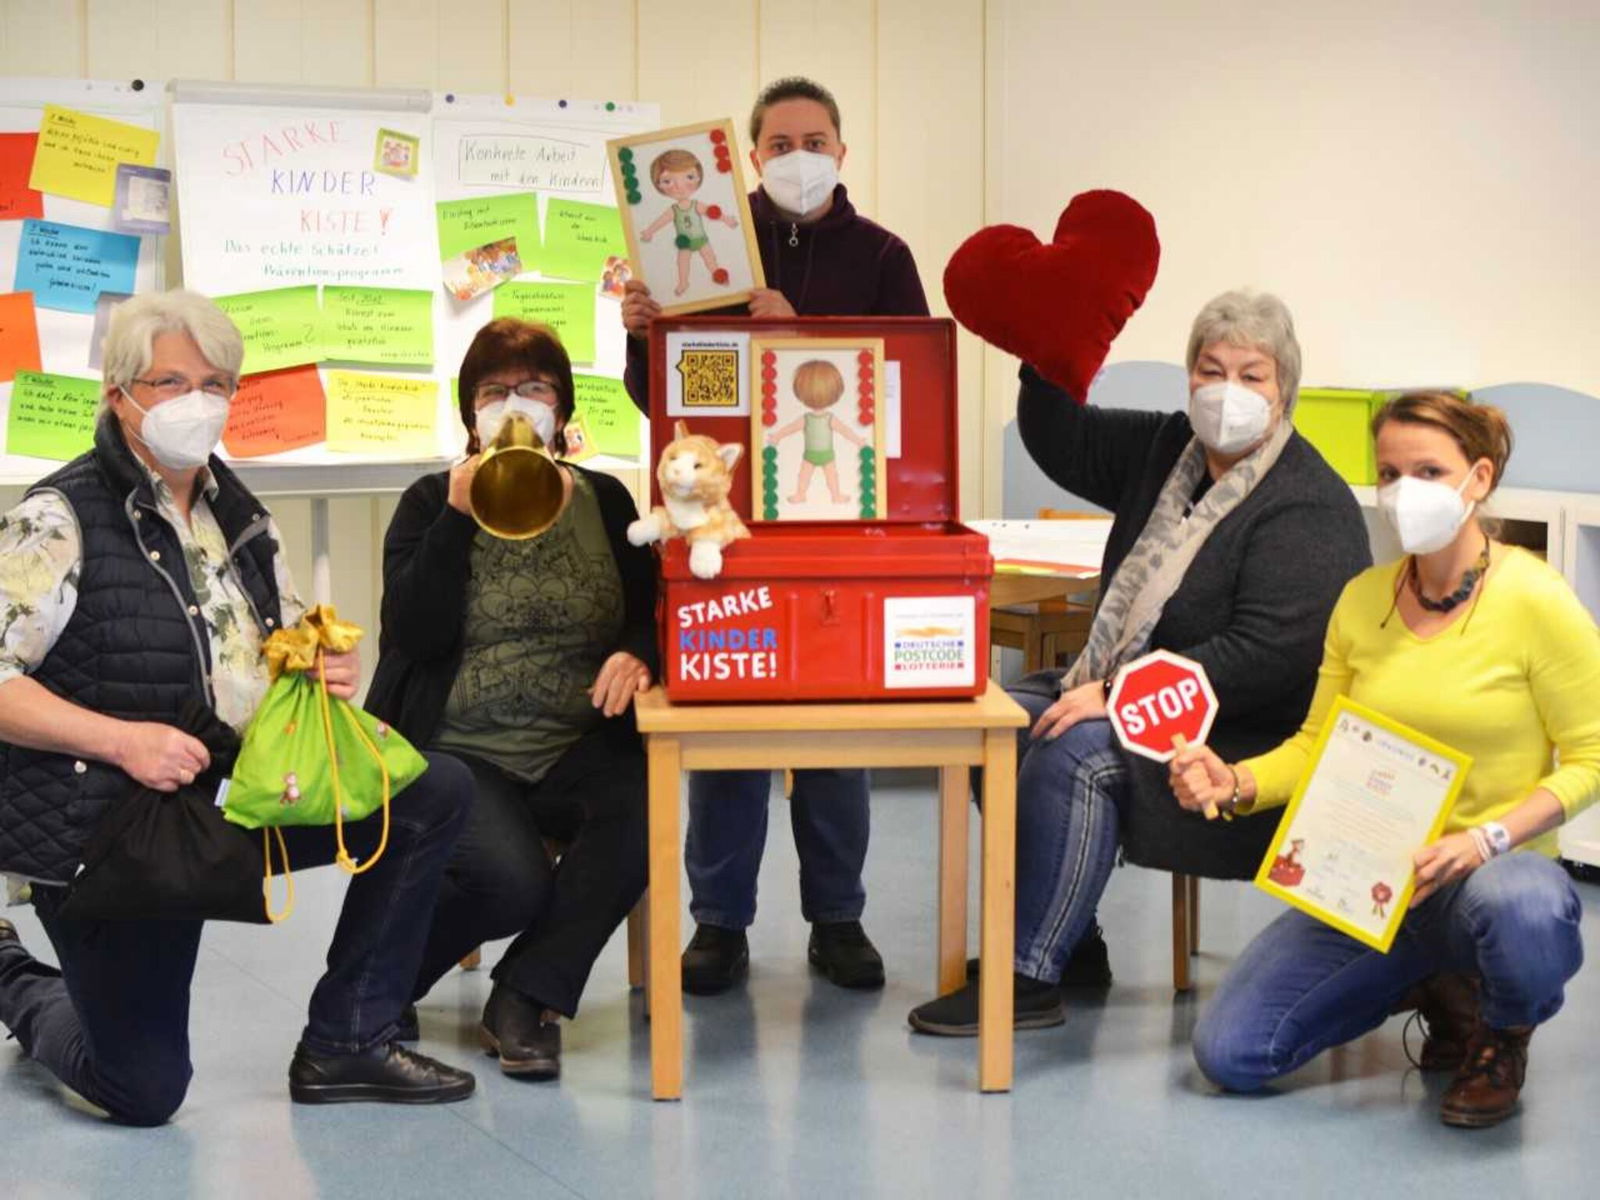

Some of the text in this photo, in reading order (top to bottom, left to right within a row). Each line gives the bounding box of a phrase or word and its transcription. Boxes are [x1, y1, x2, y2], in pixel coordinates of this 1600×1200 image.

[222, 120, 345, 177] STARKE
[271, 168, 377, 196] KINDER
[677, 586, 773, 628] STARKE
[679, 628, 778, 651] KINDER
[902, 640, 956, 649] DEUTSCHE
[680, 652, 777, 681] KISTE!
[894, 649, 964, 662] POSTCODE
[902, 662, 957, 671] LOTTERIE
[1120, 678, 1200, 736] STOP
